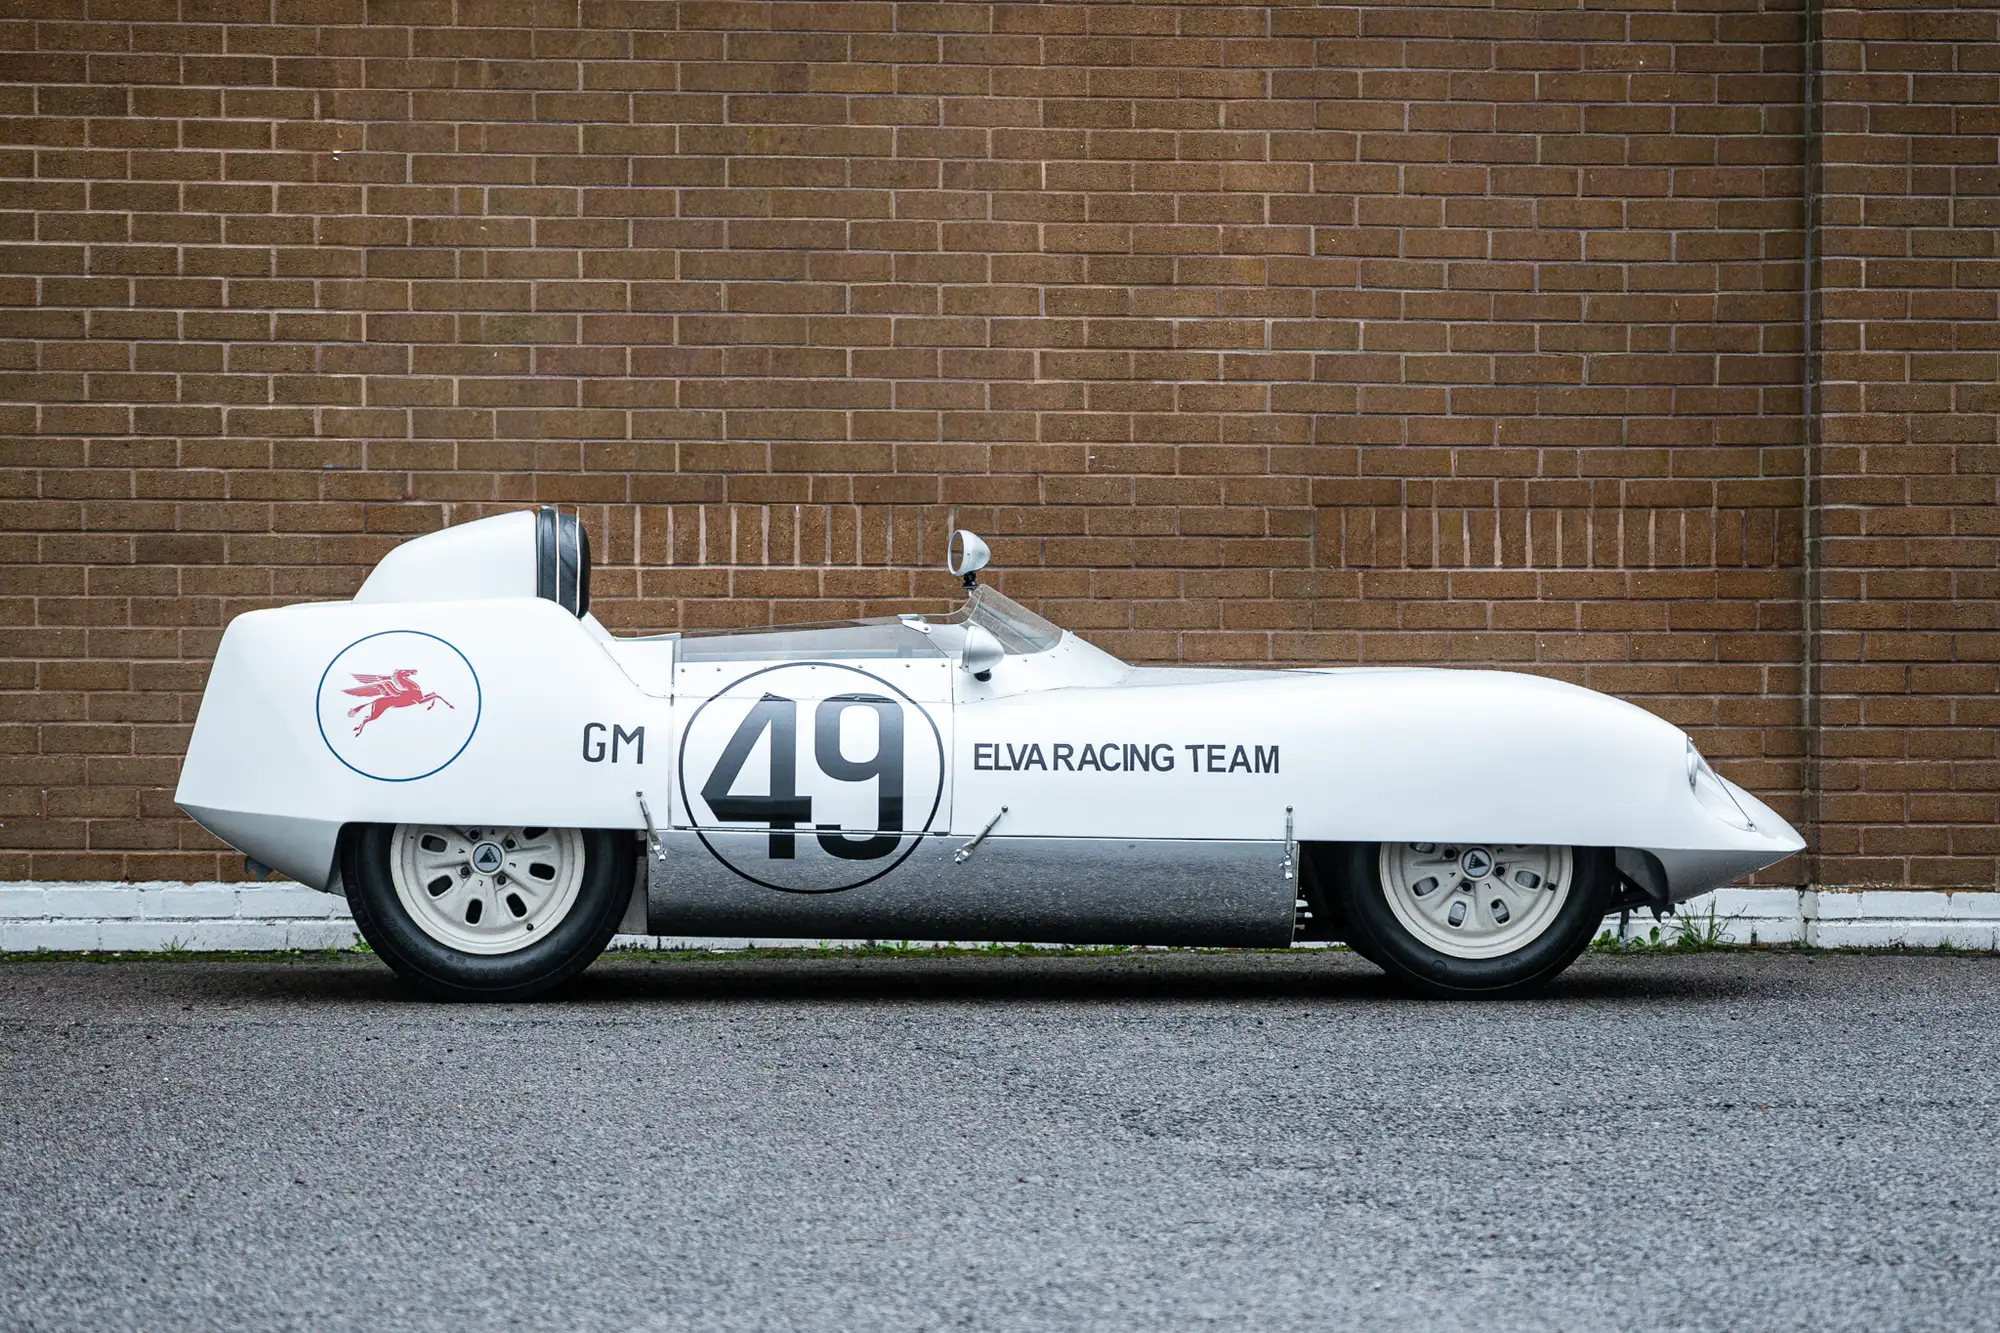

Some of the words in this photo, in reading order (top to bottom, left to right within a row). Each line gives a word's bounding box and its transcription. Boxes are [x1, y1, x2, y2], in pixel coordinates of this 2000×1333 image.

[583, 723, 645, 765] GM
[974, 743, 1048, 771] ELVA
[1053, 743, 1175, 772] RACING
[1184, 744, 1279, 774] TEAM
[700, 692, 904, 860] 49
